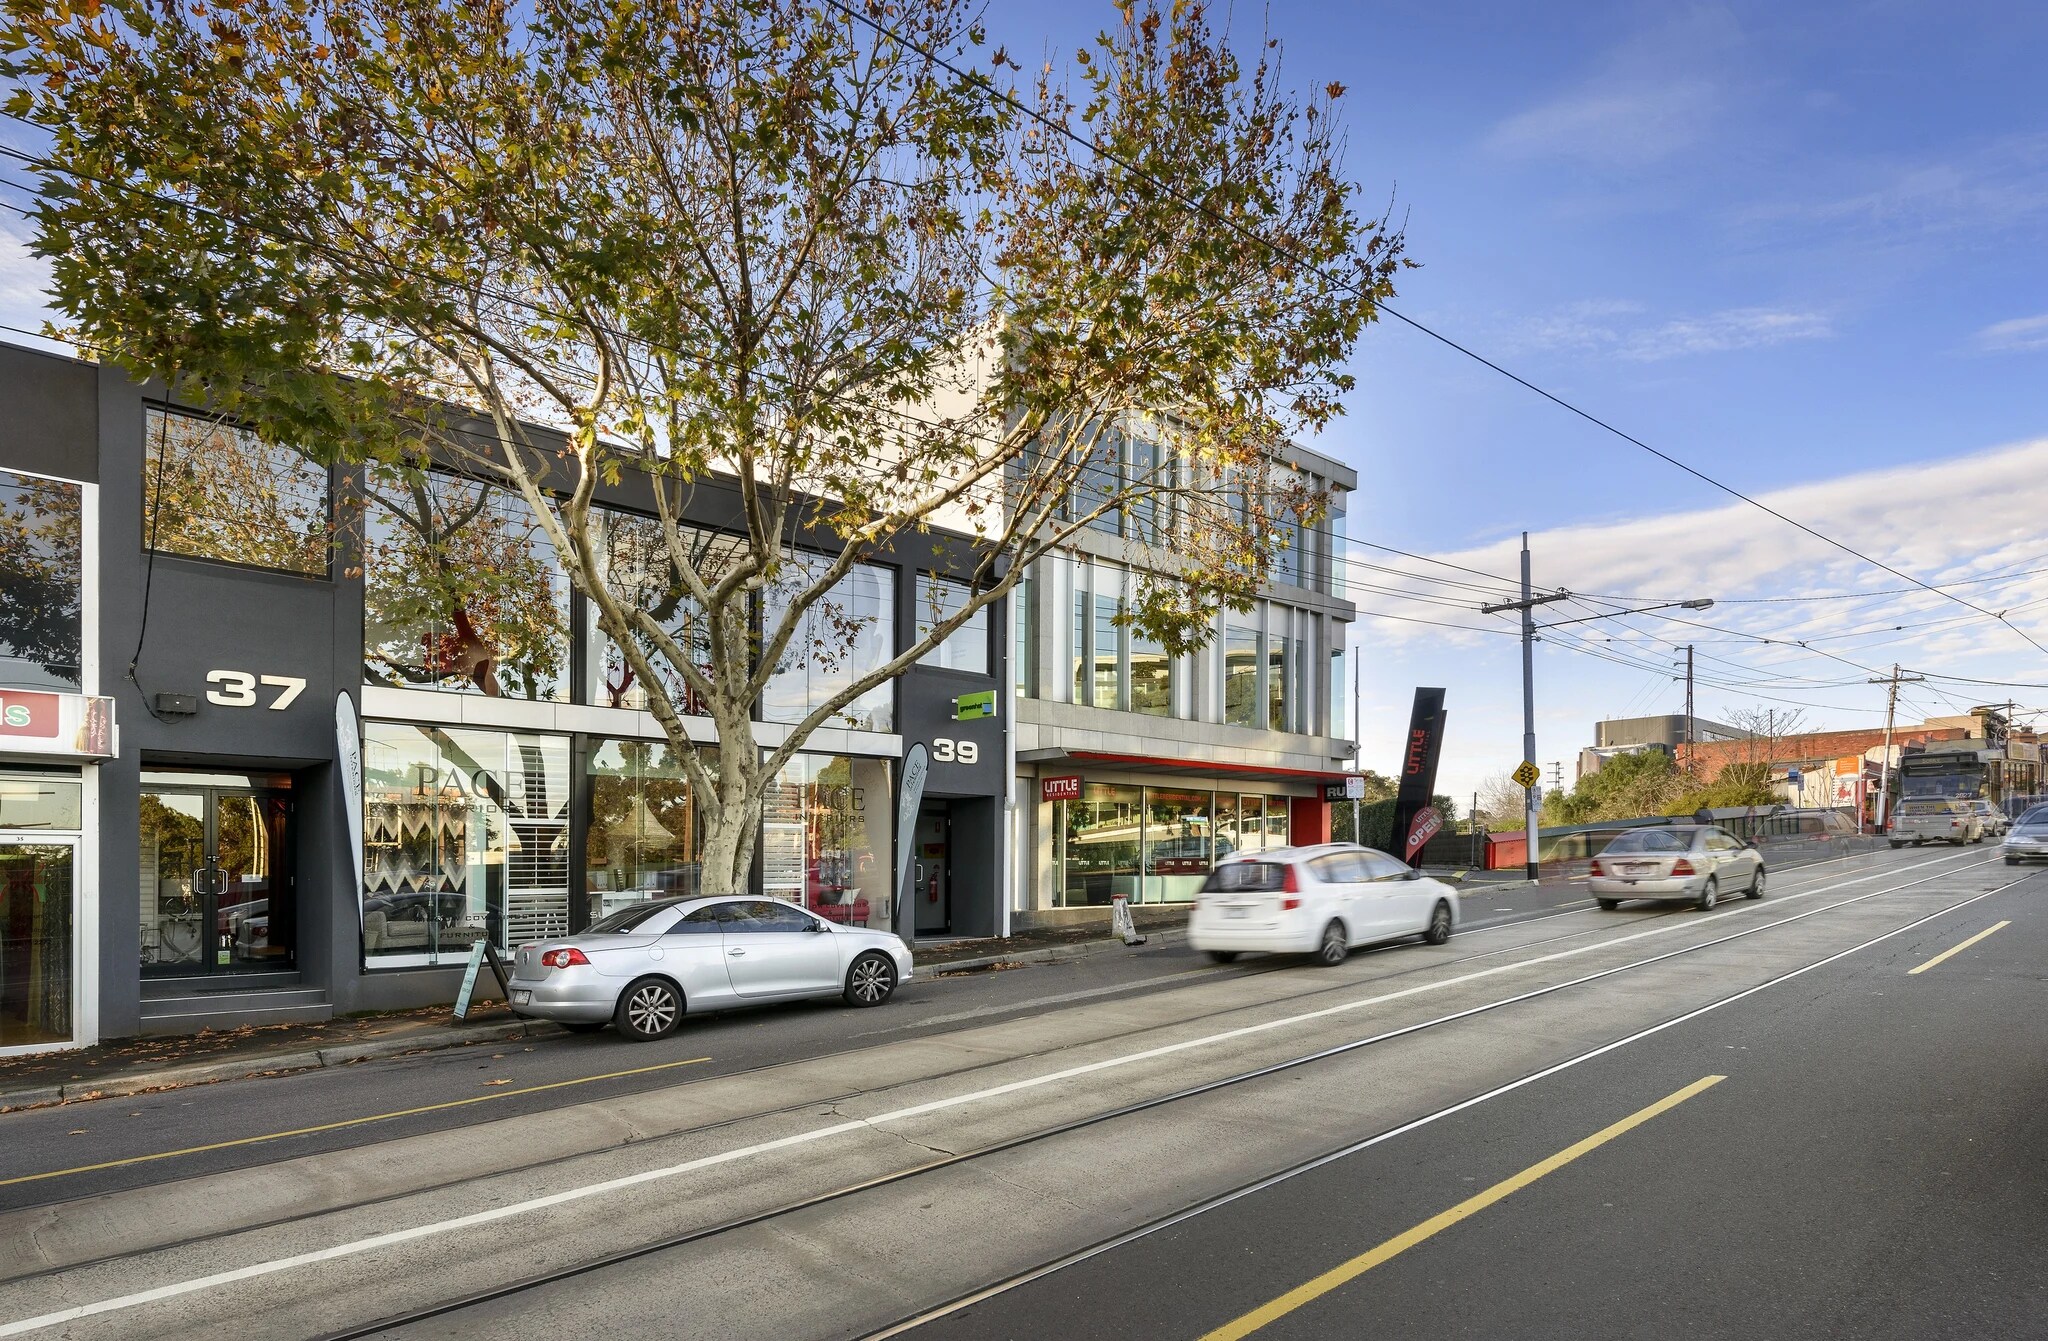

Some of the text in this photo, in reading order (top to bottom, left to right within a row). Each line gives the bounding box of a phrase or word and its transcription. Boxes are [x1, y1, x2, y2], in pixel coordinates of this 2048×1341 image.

[206, 670, 306, 710] 37
[0, 697, 31, 727] s
[933, 738, 978, 764] 39
[1407, 729, 1426, 774] LITTLE
[413, 766, 526, 799] PACE
[1044, 779, 1077, 793] LITTLE
[1327, 787, 1346, 796] RU
[1408, 814, 1441, 846] OPEN
[440, 931, 488, 939] FURNITU
